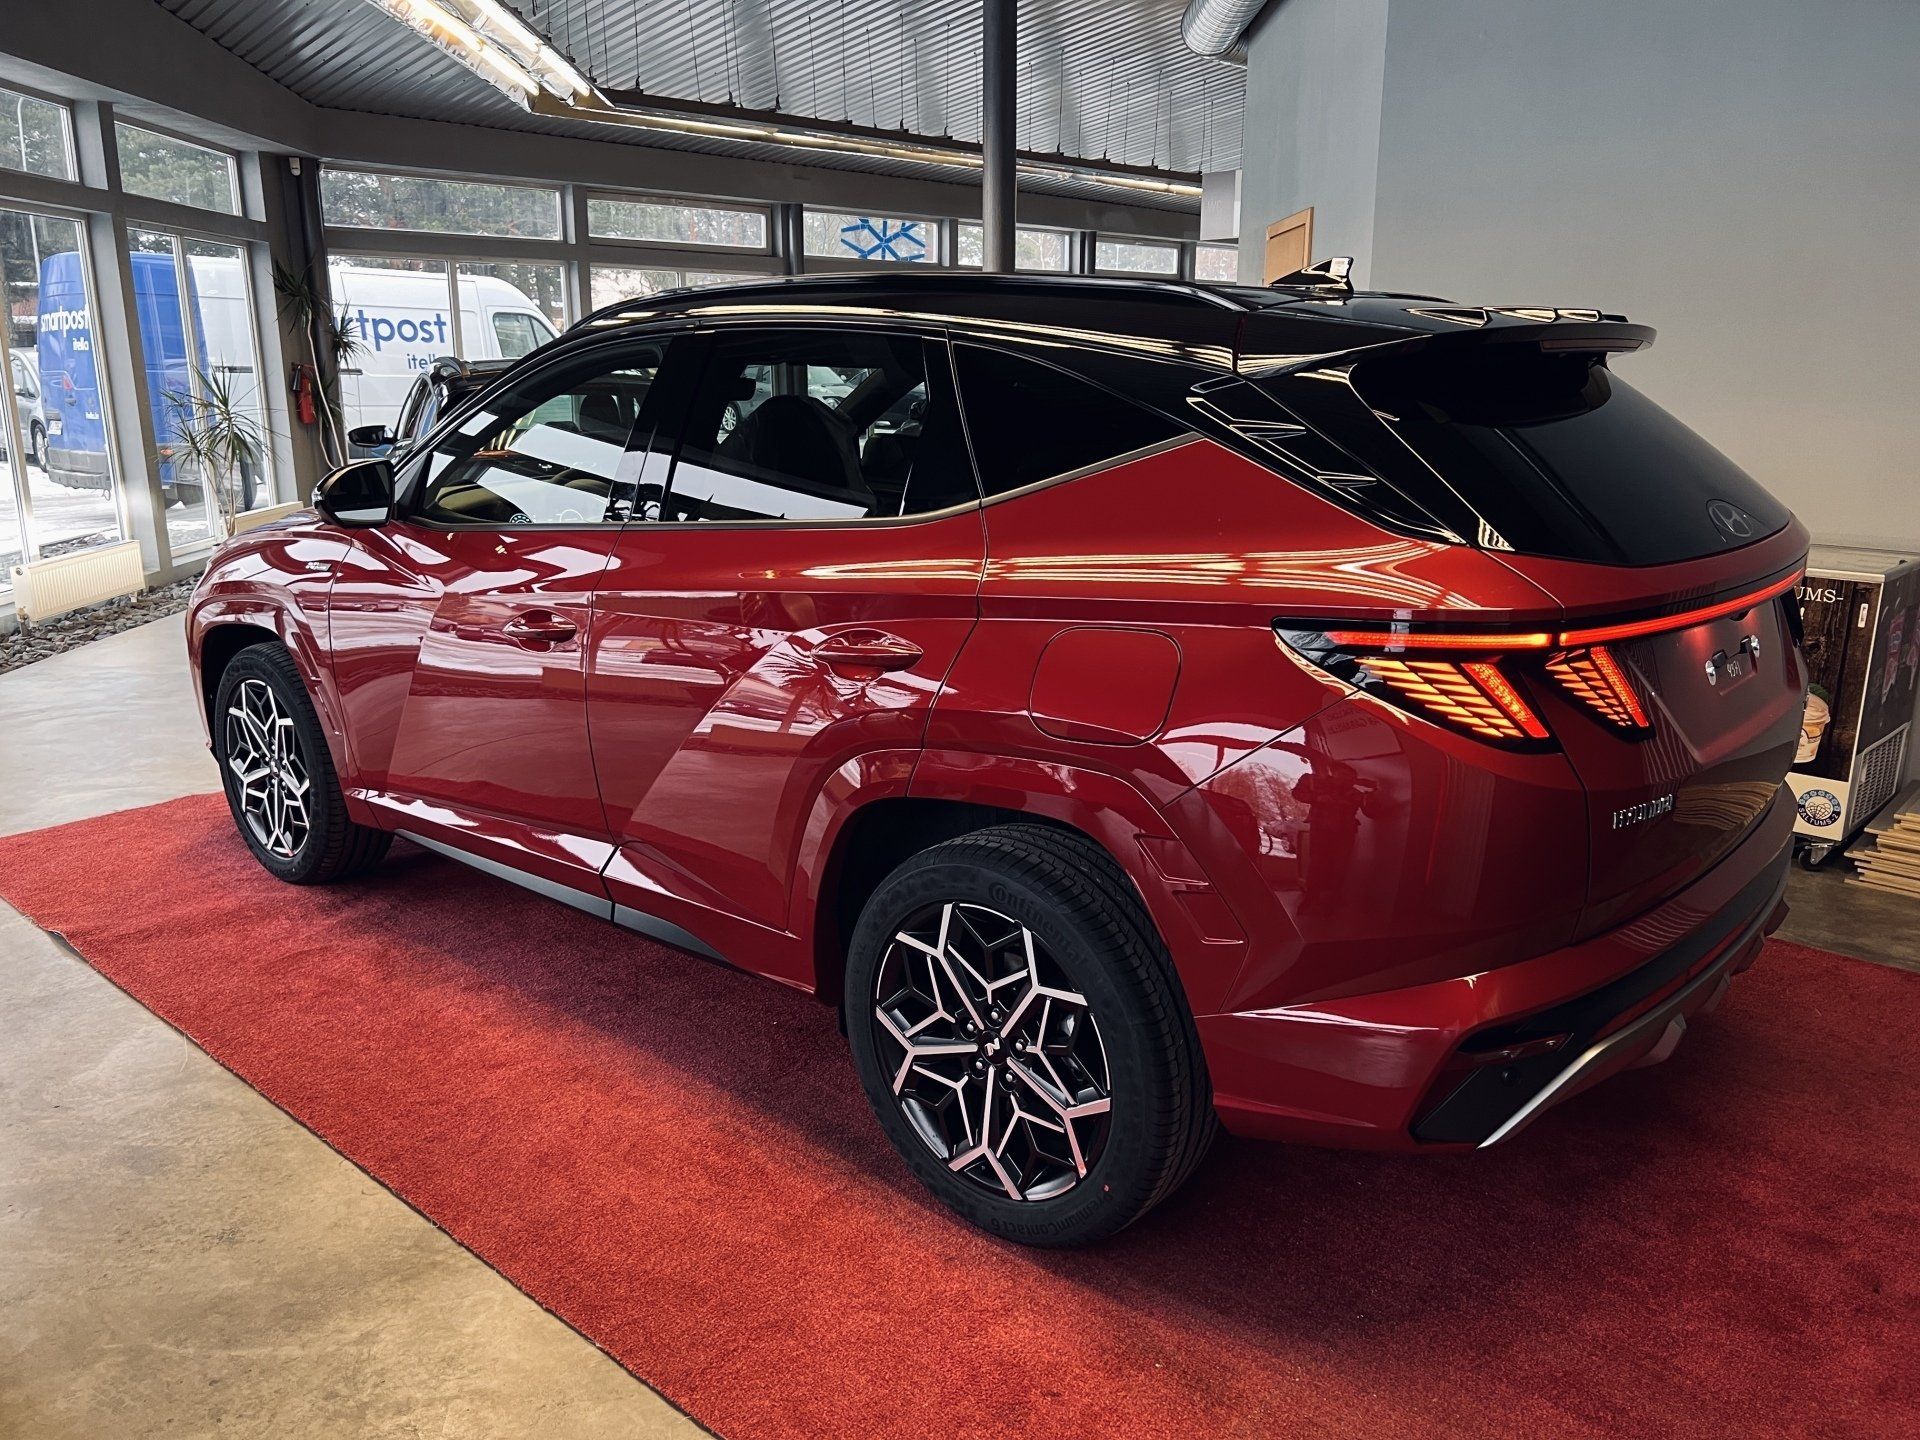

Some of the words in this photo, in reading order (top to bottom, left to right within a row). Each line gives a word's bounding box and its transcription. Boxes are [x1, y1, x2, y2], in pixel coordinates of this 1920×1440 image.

[41, 304, 90, 338] smartpost
[333, 309, 447, 352] rtpost
[1795, 586, 1844, 603] UMS-
[1798, 807, 1838, 826] SALTUMS-2
